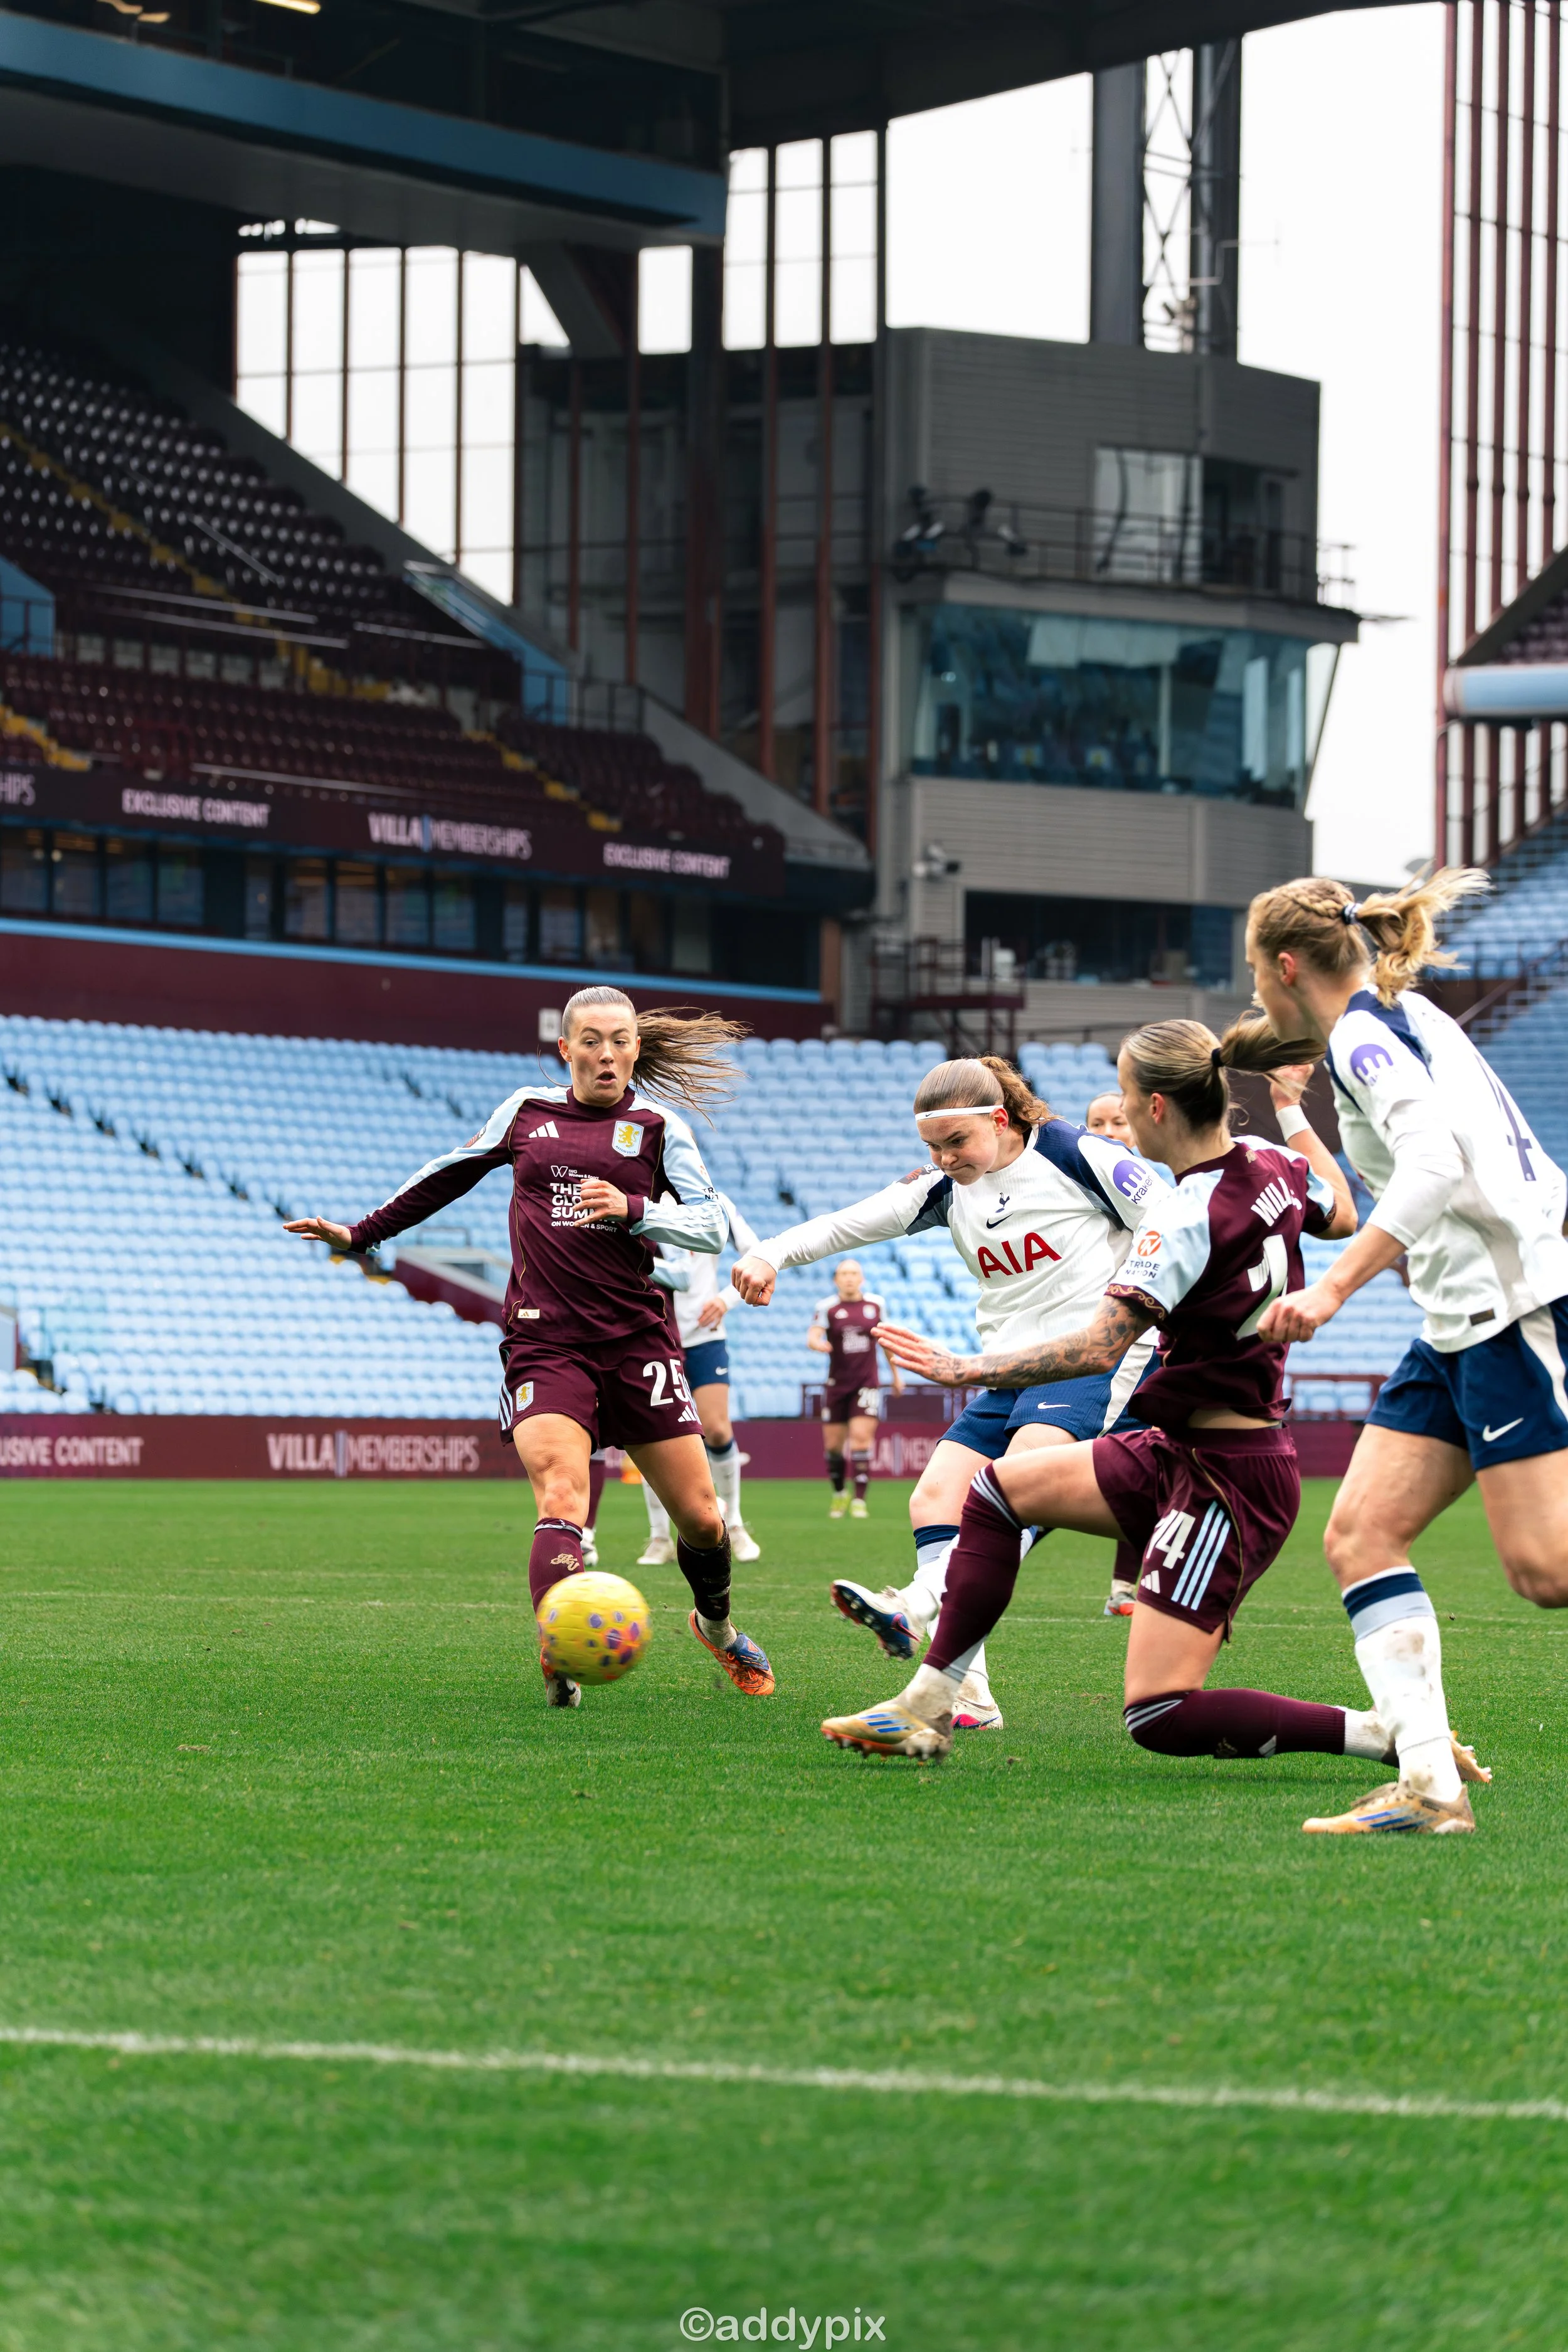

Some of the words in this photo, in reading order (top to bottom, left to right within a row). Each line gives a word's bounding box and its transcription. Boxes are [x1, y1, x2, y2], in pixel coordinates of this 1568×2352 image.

[122, 788, 201, 820] EXCLUSIVE
[203, 797, 270, 827] CONTENT
[368, 813, 420, 846] VILLA
[430, 816, 532, 860] MEMBERSHIPS
[603, 842, 670, 874] EXCLUSIVE
[672, 851, 730, 878] CONTENT
[550, 1183, 582, 1195] THE
[596, 1224, 617, 1232] SPORT
[977, 1232, 1062, 1278] AIA
[643, 1359, 690, 1406] 25
[54, 1436, 144, 1466] CONTENT
[267, 1433, 336, 1470] VILLA
[346, 1434, 480, 1472] MEMBERSHIPS
